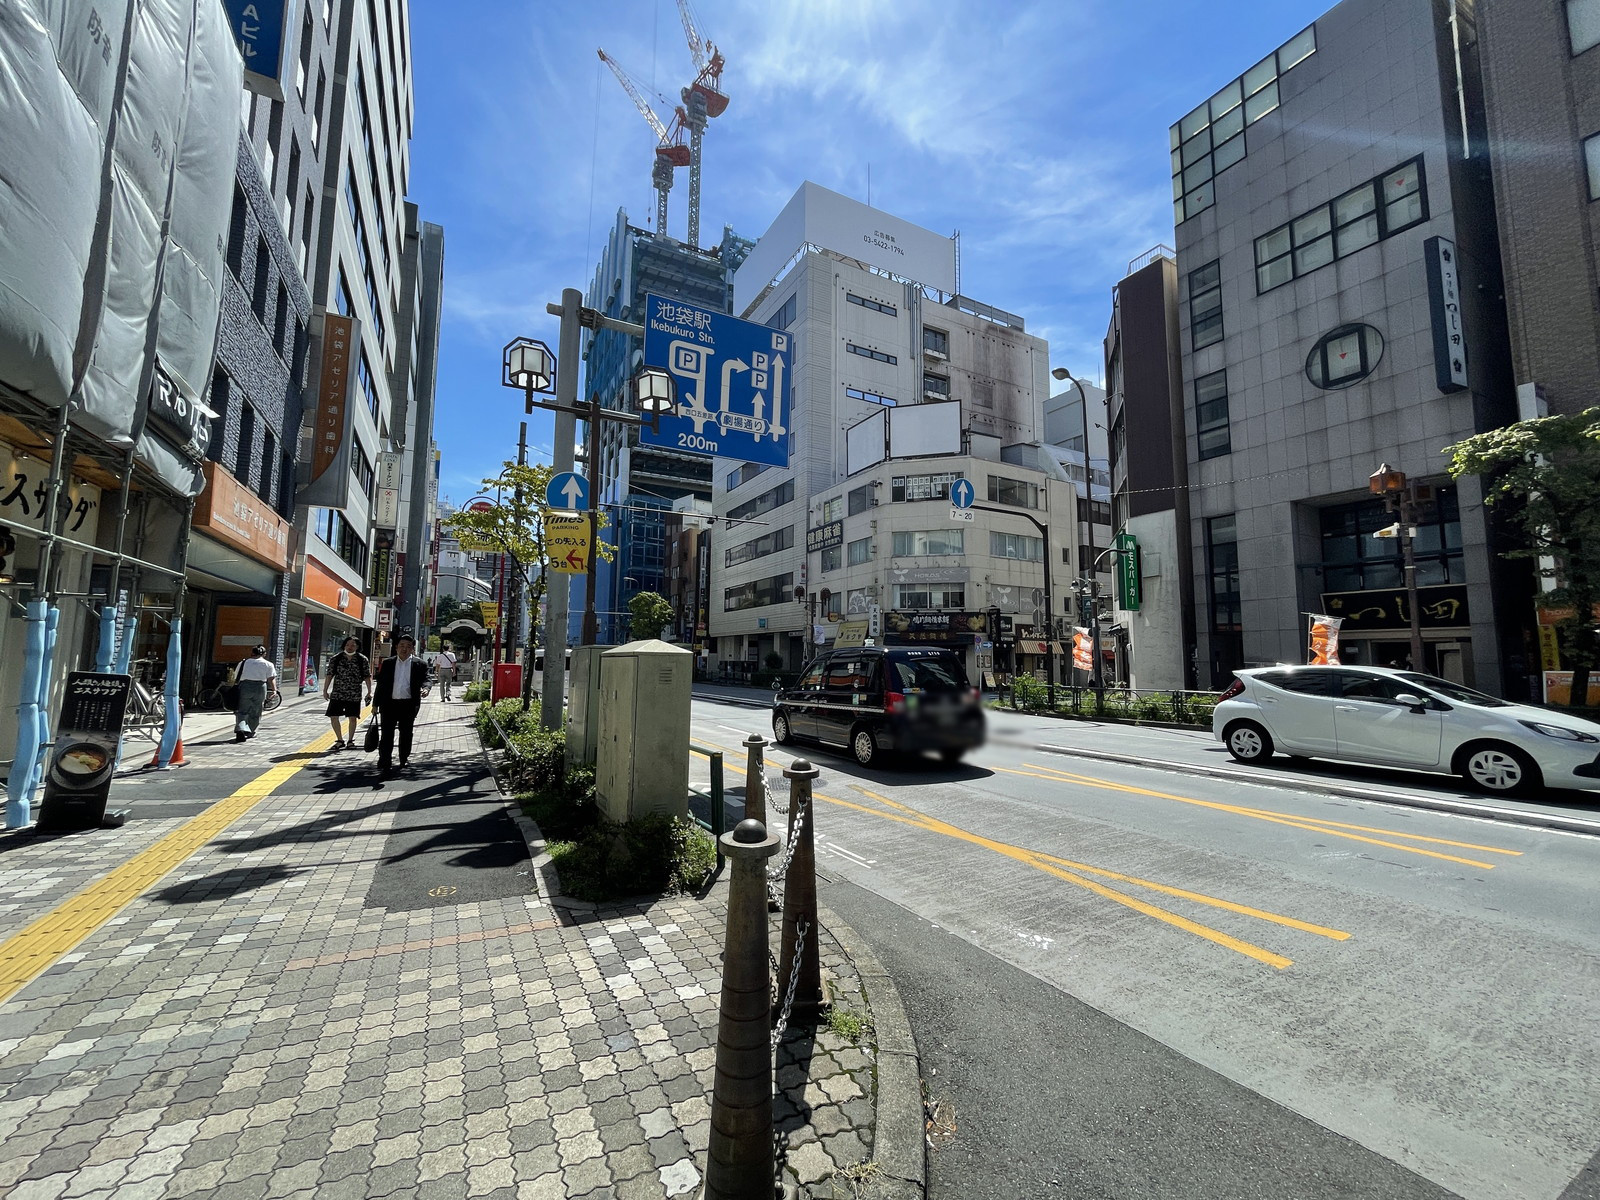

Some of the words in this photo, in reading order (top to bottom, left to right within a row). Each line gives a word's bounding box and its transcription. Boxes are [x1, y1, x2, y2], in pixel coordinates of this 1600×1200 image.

[86, 6, 112, 67] 防音
[863, 234, 905, 256] 03-5422-1794
[656, 300, 712, 332] 池袋駅
[650, 318, 695, 339] Ikebukuro
[698, 331, 716, 345] Stn.
[776, 335, 785, 349] P
[683, 352, 694, 367] P
[756, 354, 766, 368] P
[755, 373, 765, 386] P
[324, 325, 346, 456] 池袋アセリア通り歯科
[722, 414, 764, 432] 劇場通り
[677, 432, 719, 453] 200m
[544, 515, 585, 526] Times
[547, 537, 587, 547] この先入る
[807, 522, 842, 545] 健康麻雀
[550, 556, 568, 569] 5台
[1126, 551, 1138, 605] モスバーガー
